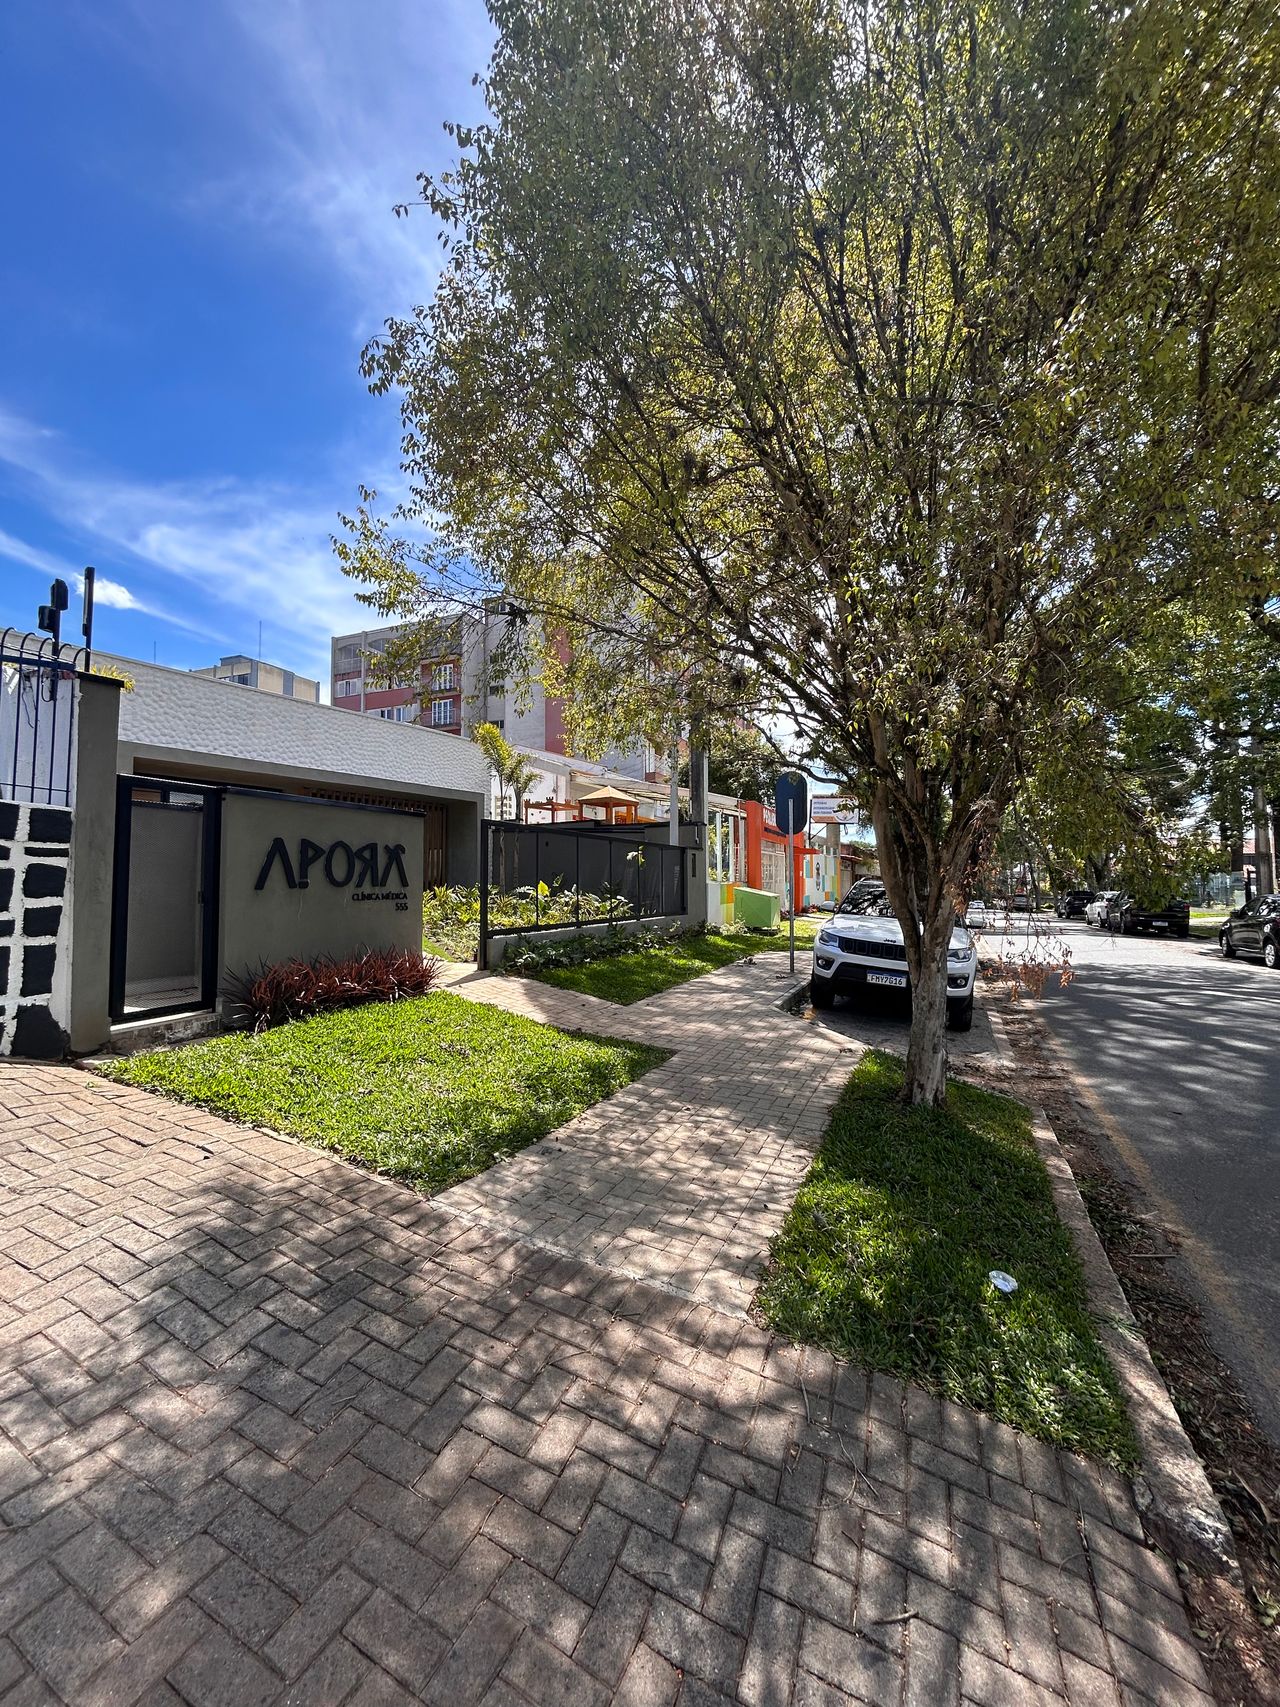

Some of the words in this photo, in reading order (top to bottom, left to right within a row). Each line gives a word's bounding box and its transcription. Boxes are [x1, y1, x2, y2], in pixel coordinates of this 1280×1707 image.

[352, 891, 380, 901] CLÍNICA
[381, 890, 408, 901] MÉDICA
[395, 902, 408, 911] 555
[870, 975, 903, 985] FMY7G16
